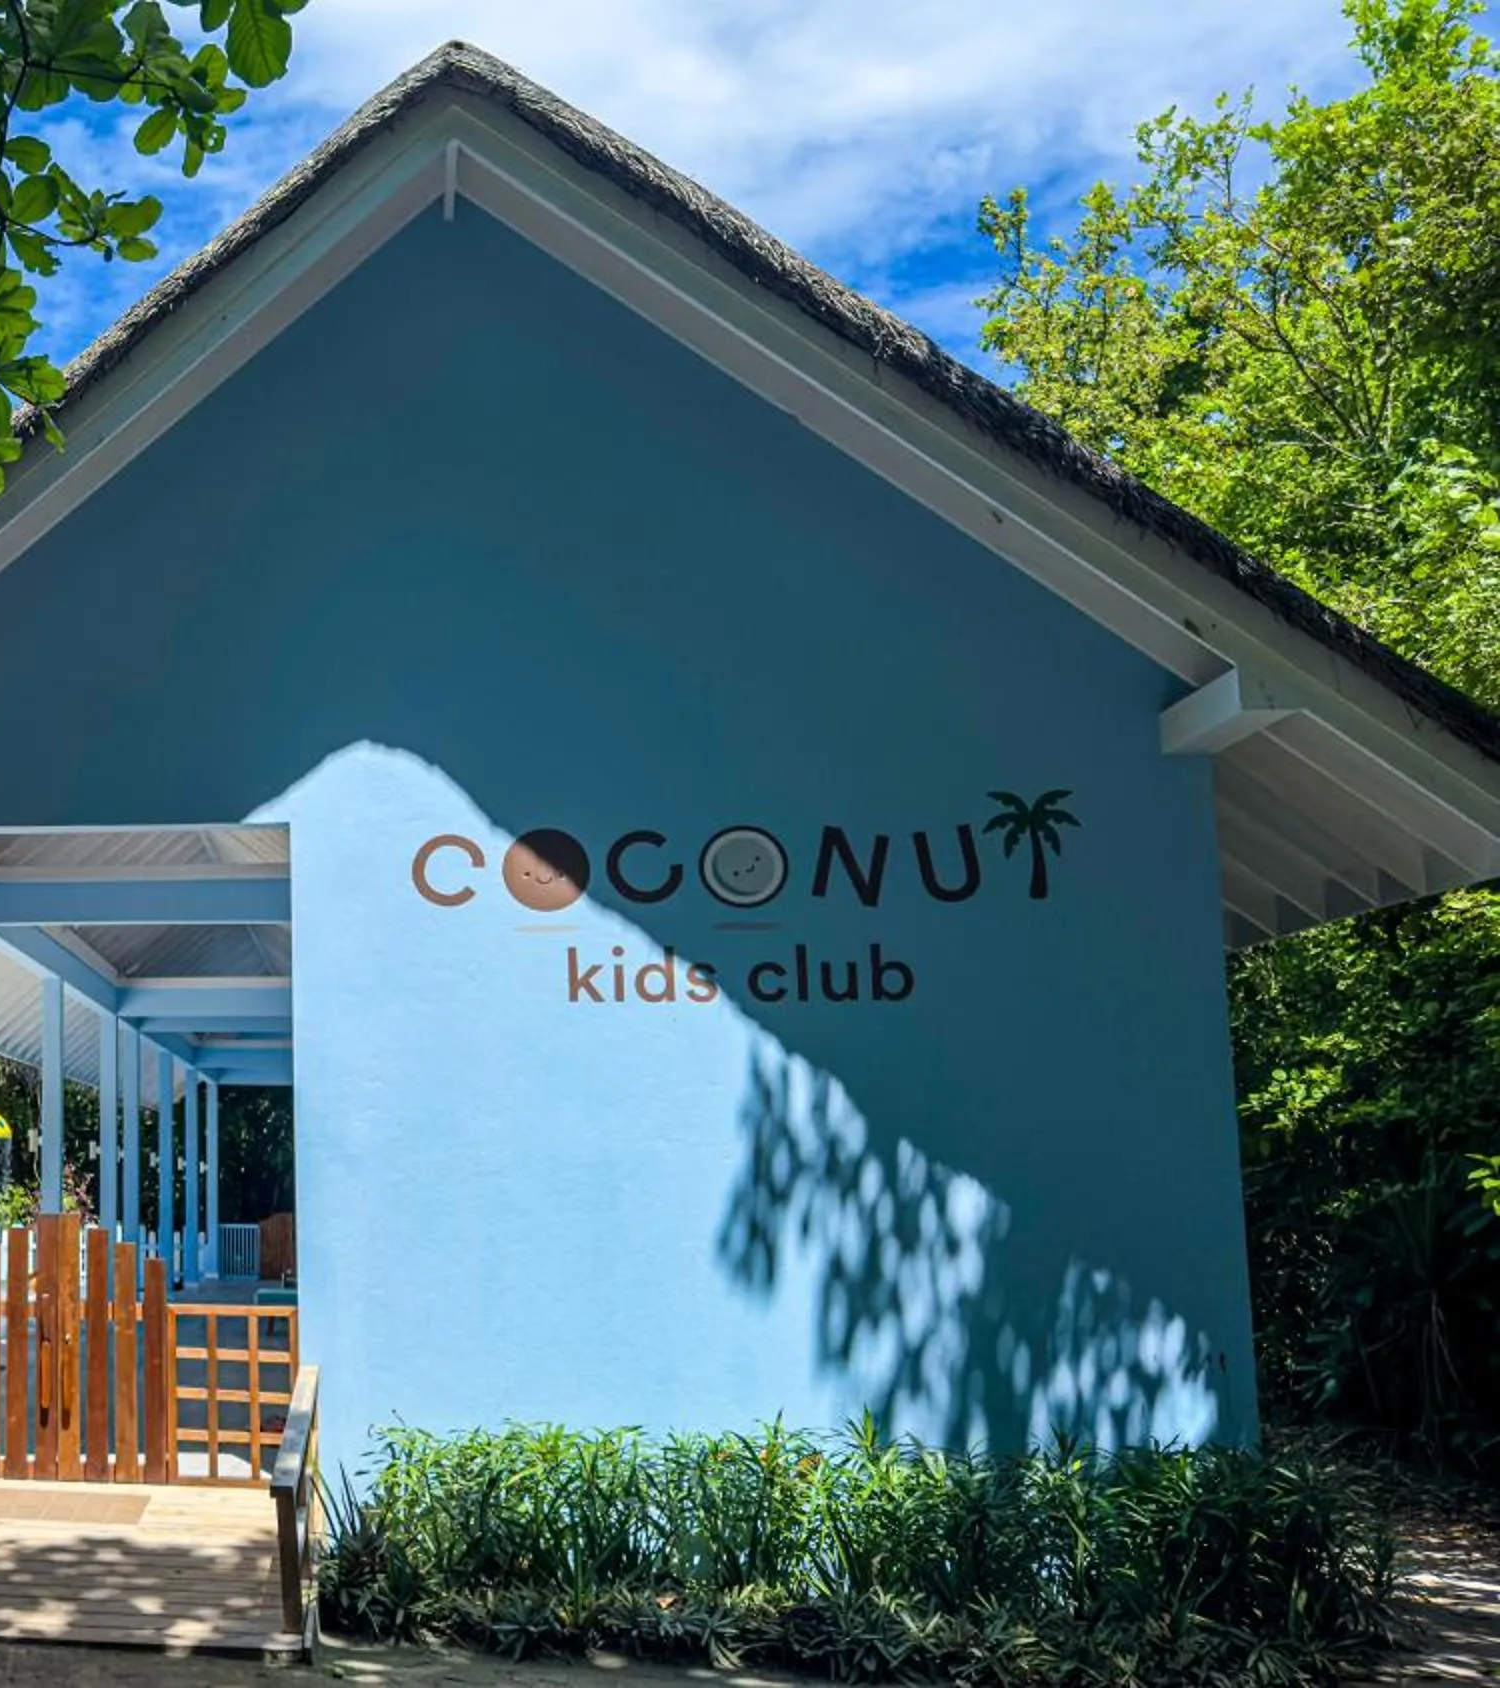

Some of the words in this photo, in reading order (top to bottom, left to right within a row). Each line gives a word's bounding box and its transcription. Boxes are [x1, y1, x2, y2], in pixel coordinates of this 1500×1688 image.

[411, 790, 1082, 911] COCONUT
[567, 947, 719, 1003] kids
[747, 944, 915, 1002] club
